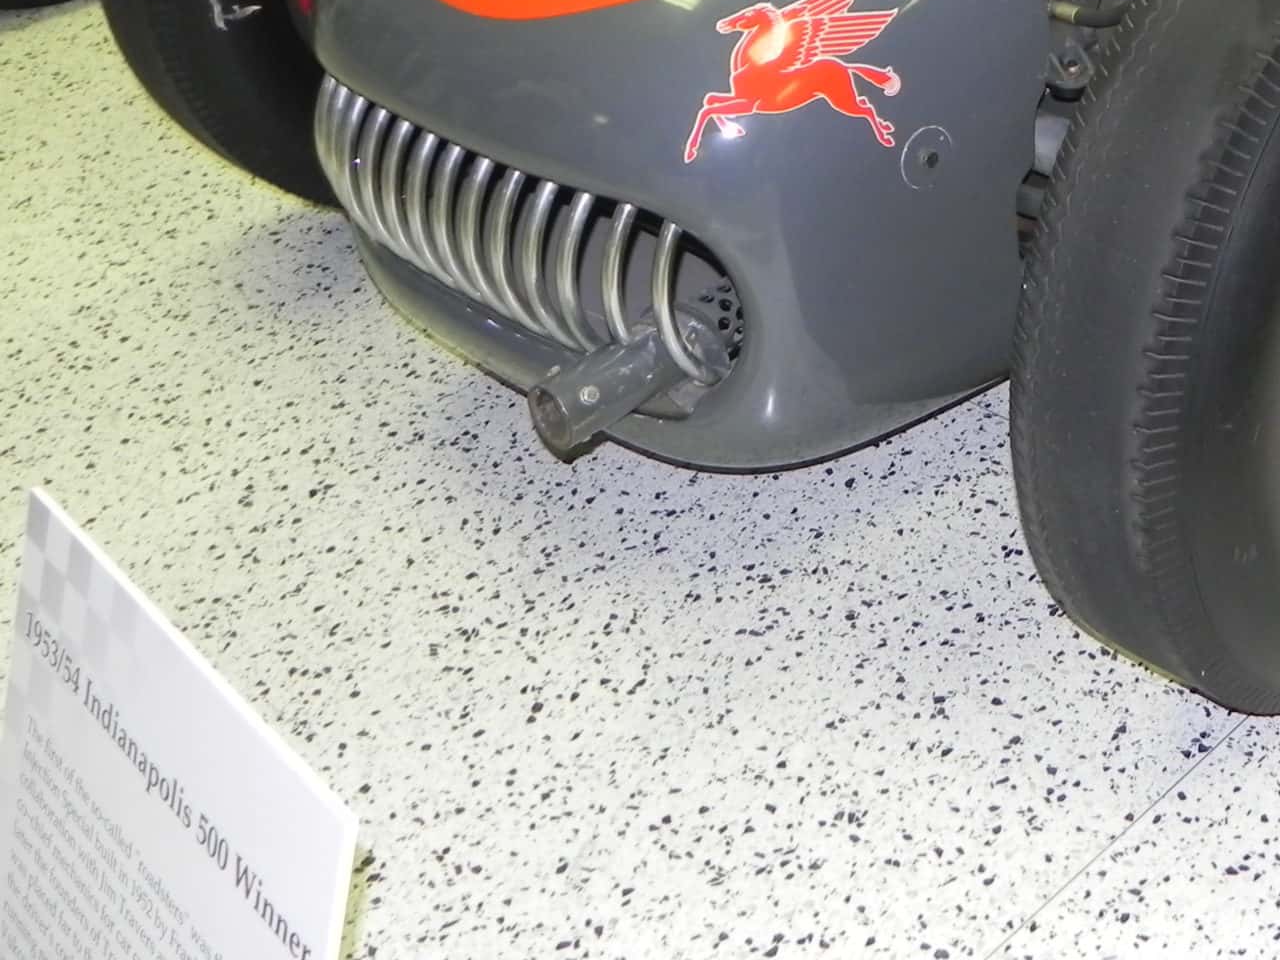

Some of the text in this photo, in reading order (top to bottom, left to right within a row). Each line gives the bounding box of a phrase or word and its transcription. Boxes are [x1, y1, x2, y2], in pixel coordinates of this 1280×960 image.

[26, 611, 312, 960] 1953/54 Indianapolis 500 Winner
[64, 758, 75, 790] of
[98, 867, 117, 909] Jim
[118, 894, 155, 960] Travers
[130, 877, 152, 924] 1952
[153, 907, 167, 943] by
